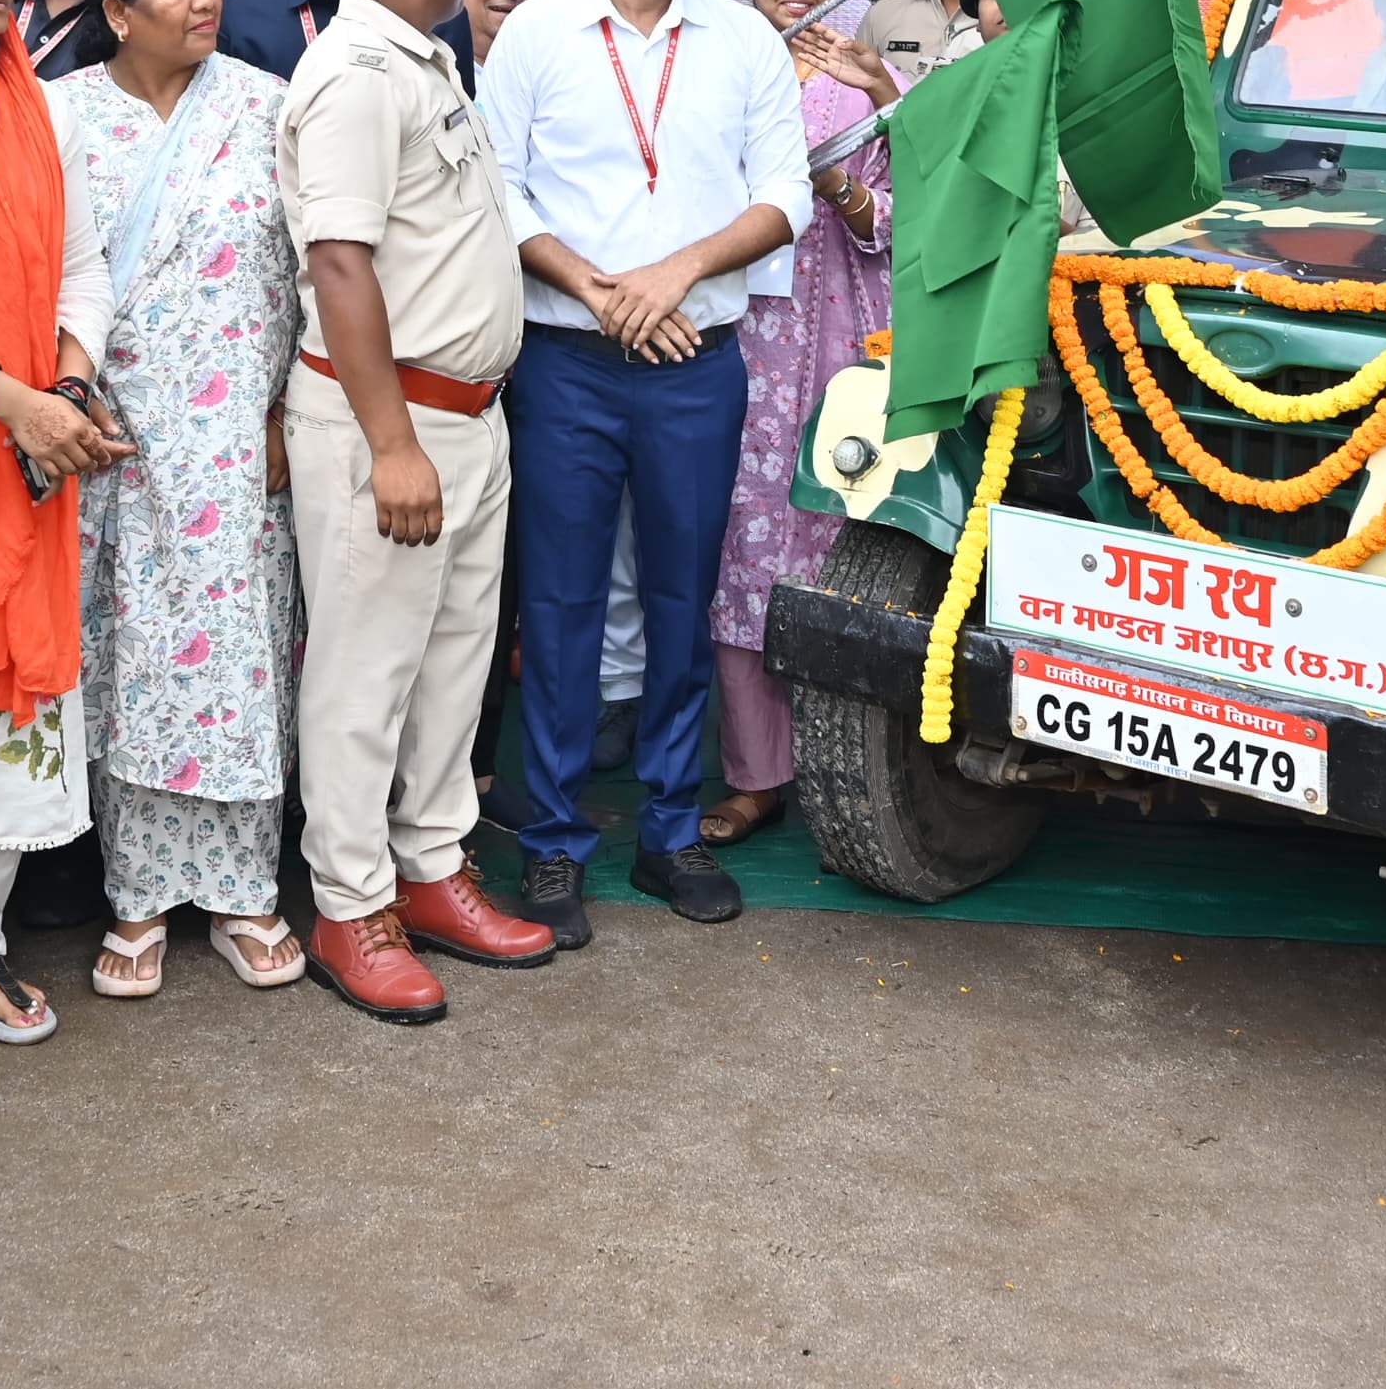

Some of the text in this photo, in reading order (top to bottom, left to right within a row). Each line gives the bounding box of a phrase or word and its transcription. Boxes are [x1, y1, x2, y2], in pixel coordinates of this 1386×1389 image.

[1103, 545, 1277, 629] गज रथ
[1018, 594, 1064, 625] वन
[1073, 603, 1165, 645] मण्डल
[1174, 626, 1274, 672] जशपुर
[1037, 694, 1295, 793] CG 15A 2479
[1132, 683, 1187, 711] शासन
[1191, 698, 1220, 720] वन
[1224, 706, 1285, 736] विभाग
